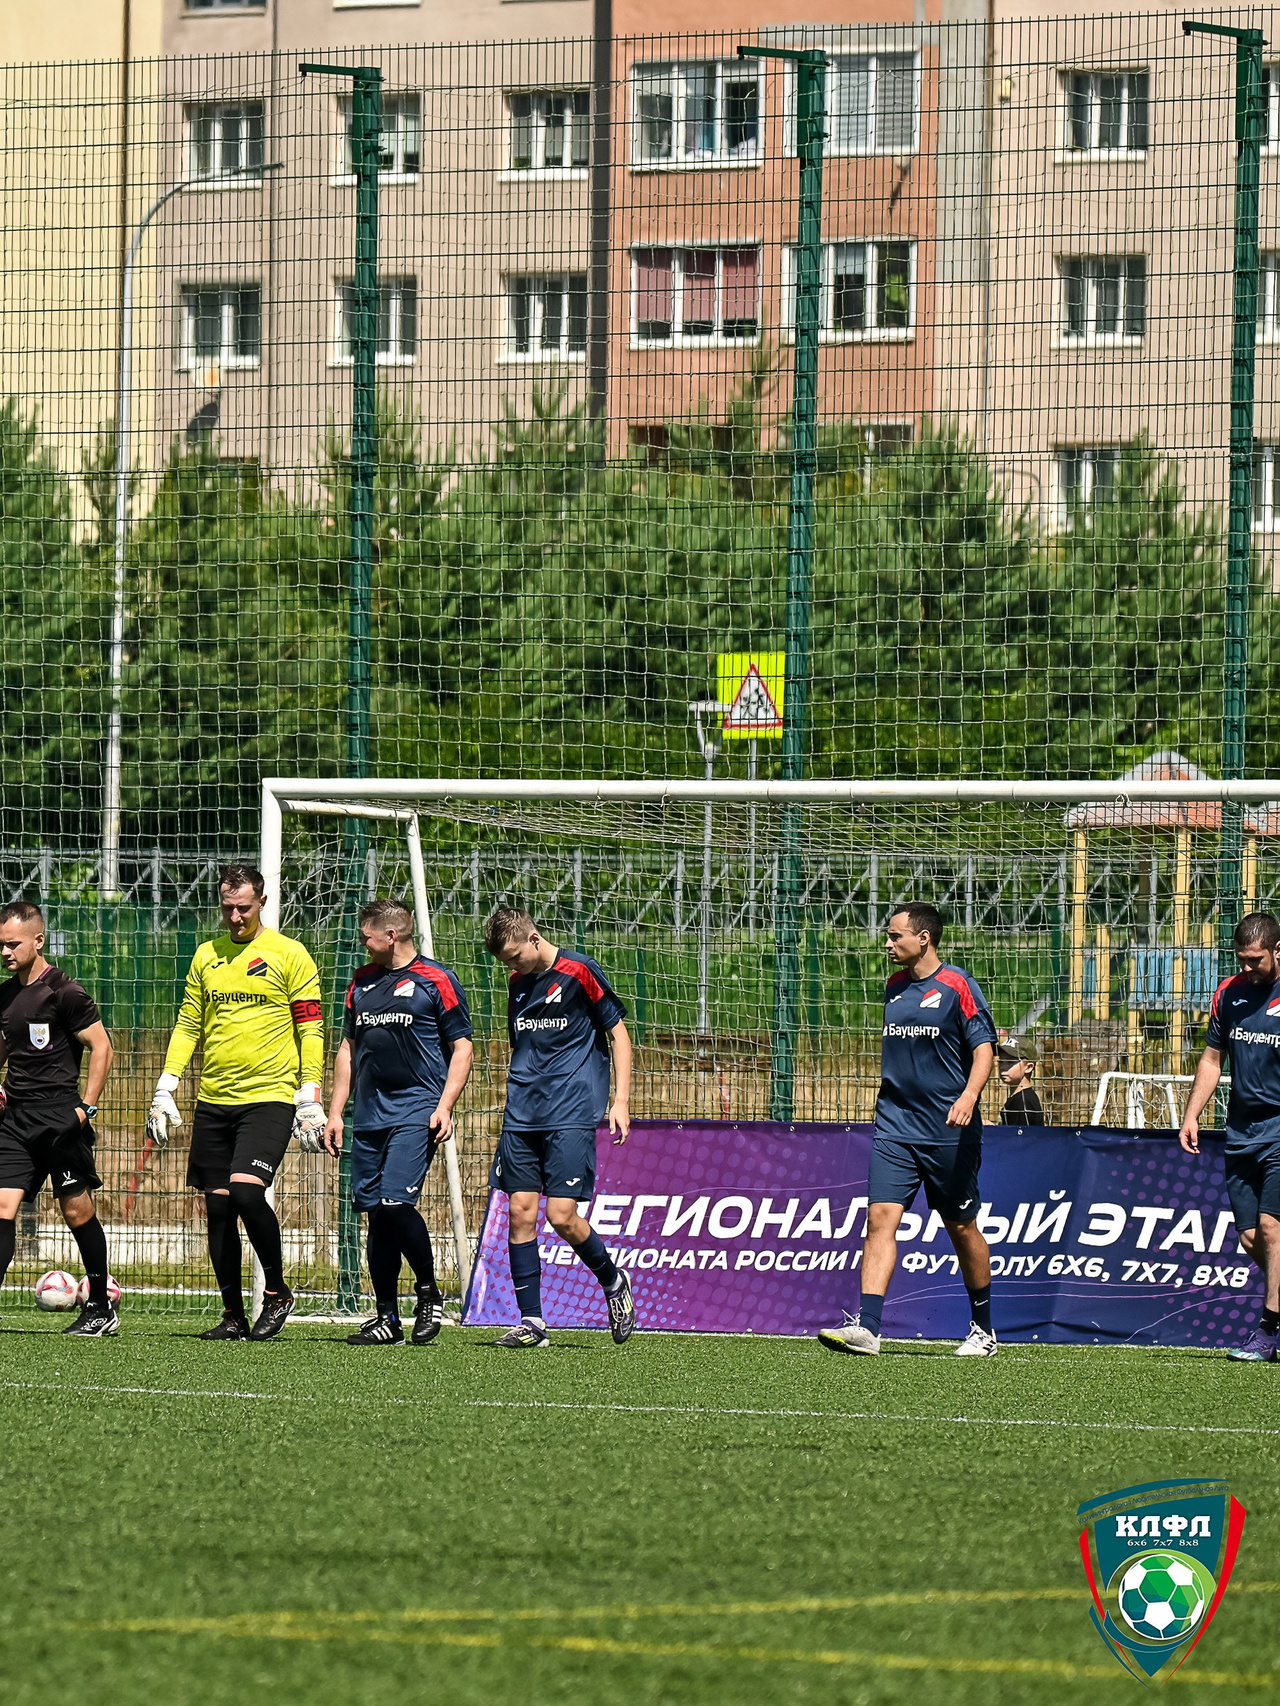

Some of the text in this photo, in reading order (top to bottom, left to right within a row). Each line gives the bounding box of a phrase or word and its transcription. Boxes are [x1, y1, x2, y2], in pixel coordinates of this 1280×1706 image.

[211, 990, 267, 1005] Бауцентр
[361, 1012, 413, 1027] Бауцентр
[517, 1017, 568, 1032] Бауцентр
[888, 1023, 940, 1039] Бауцентр
[1078, 1203, 1250, 1255] ЭТАП
[735, 1250, 847, 1272] РОССИИ
[901, 1252, 1047, 1278] ФУТОЛУ
